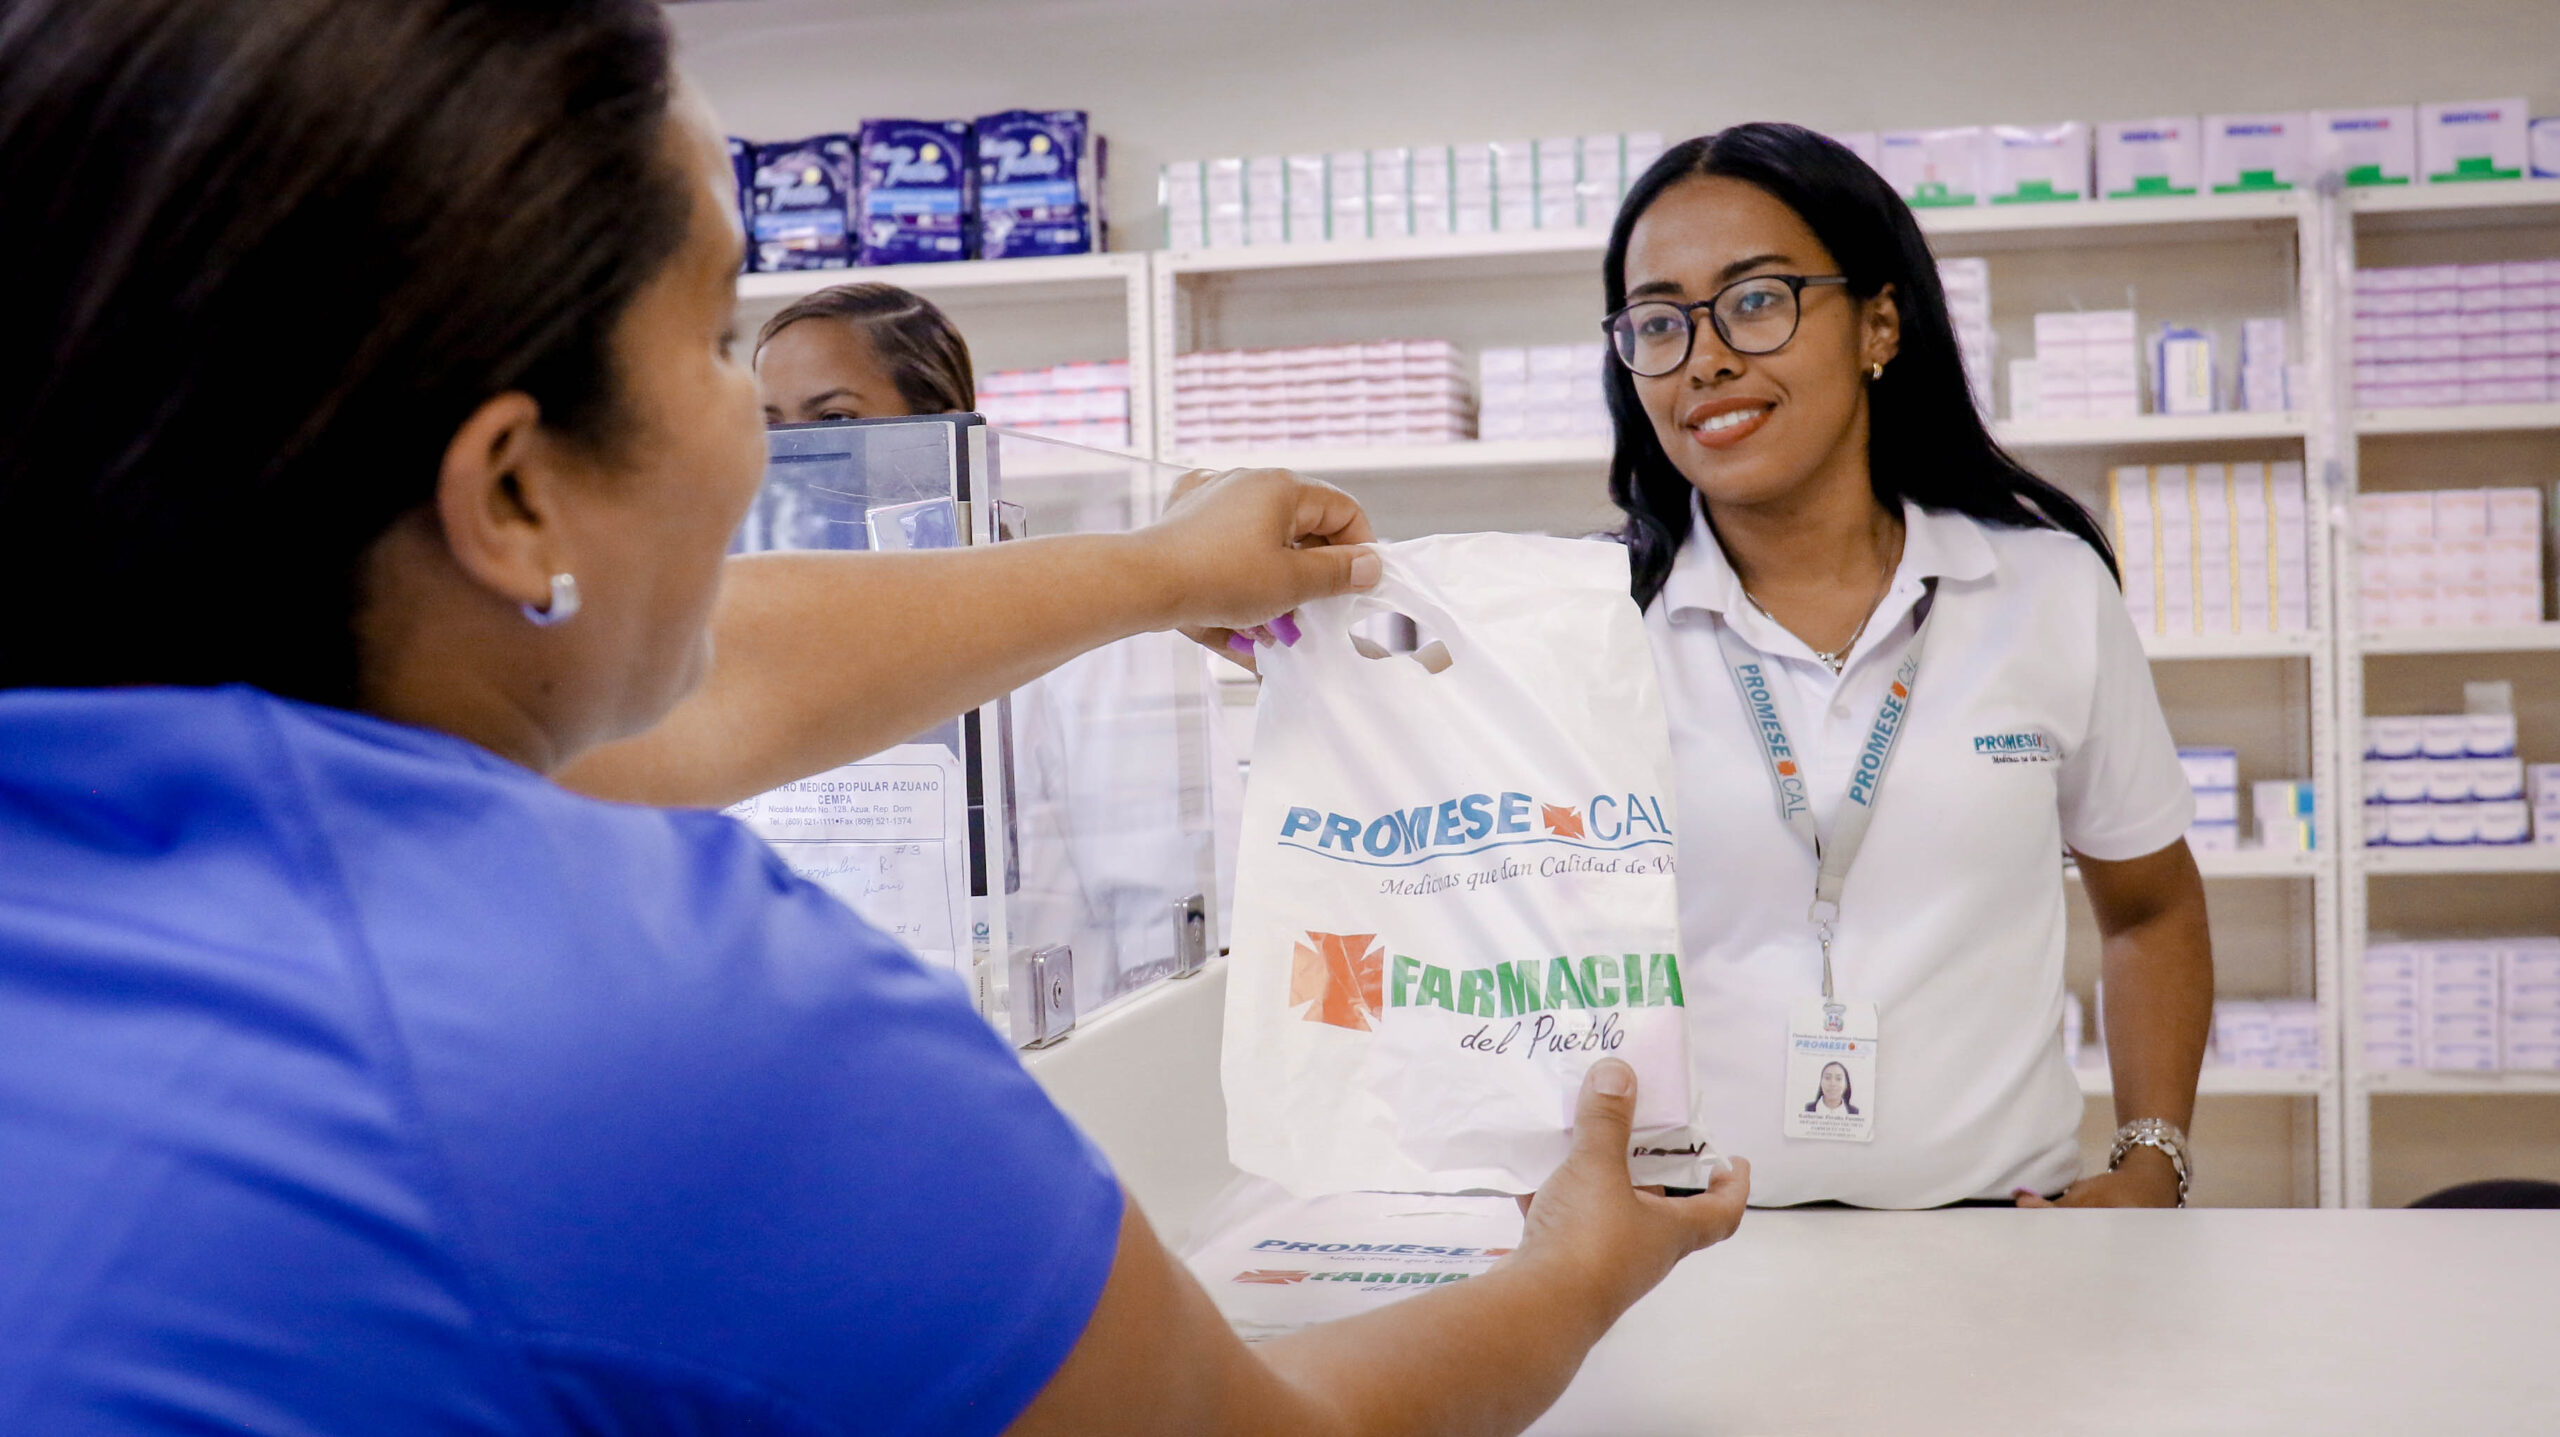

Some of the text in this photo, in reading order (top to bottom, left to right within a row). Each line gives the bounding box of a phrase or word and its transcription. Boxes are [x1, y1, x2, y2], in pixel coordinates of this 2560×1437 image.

[1739, 664, 1807, 820] PROMESE CAL
[1849, 654, 1920, 806] PROMESE CAL
[818, 794, 852, 805] CEMPA
[838, 781, 889, 792] POPULAR
[892, 781, 939, 792] AZUANO
[876, 817, 912, 826] 521-1374
[1280, 791, 1673, 857] PROMESE CAL
[1466, 865, 1499, 892] que
[1501, 856, 1534, 881] dan
[1539, 854, 1622, 878] Calidad
[1624, 857, 1647, 875] de
[1652, 853, 1676, 874] Vi
[1391, 952, 1685, 1018] FARMACIA
[1460, 1011, 1625, 1060] del Pueblo
[1795, 1040, 1847, 1051] PROMESE
[1254, 1239, 1480, 1256] PROMESE
[1310, 1271, 1469, 1284] FARMA
